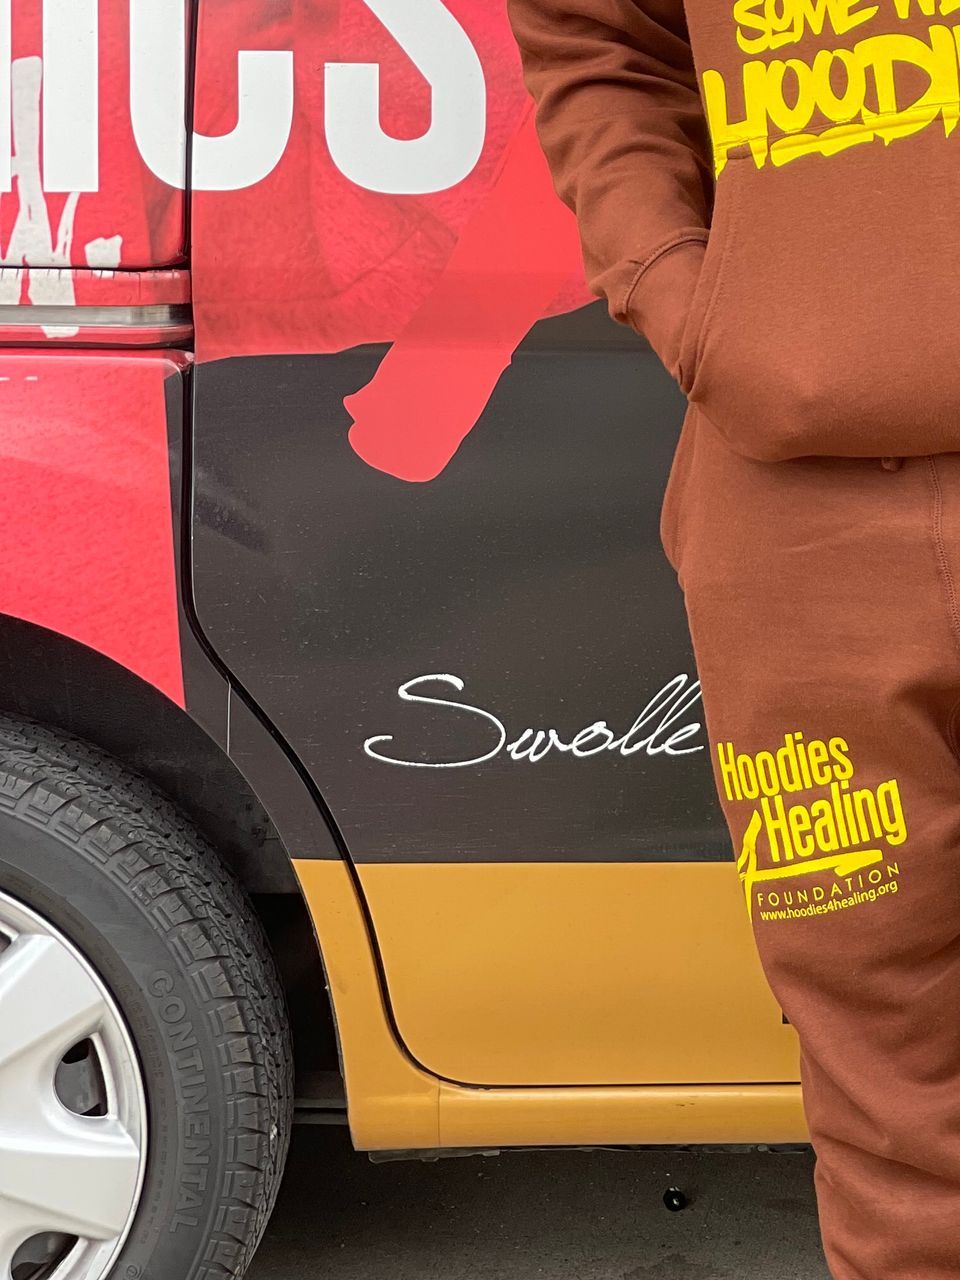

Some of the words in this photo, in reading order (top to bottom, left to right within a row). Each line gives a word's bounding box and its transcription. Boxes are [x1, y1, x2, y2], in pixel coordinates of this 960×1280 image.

[716, 731, 854, 801] Hoodies
[760, 779, 908, 863] Healing
[757, 862, 900, 907] FOUNDATION
[760, 880, 899, 921] www.hoodies4healing.org
[150, 970, 210, 1233] CONTINENTAL
